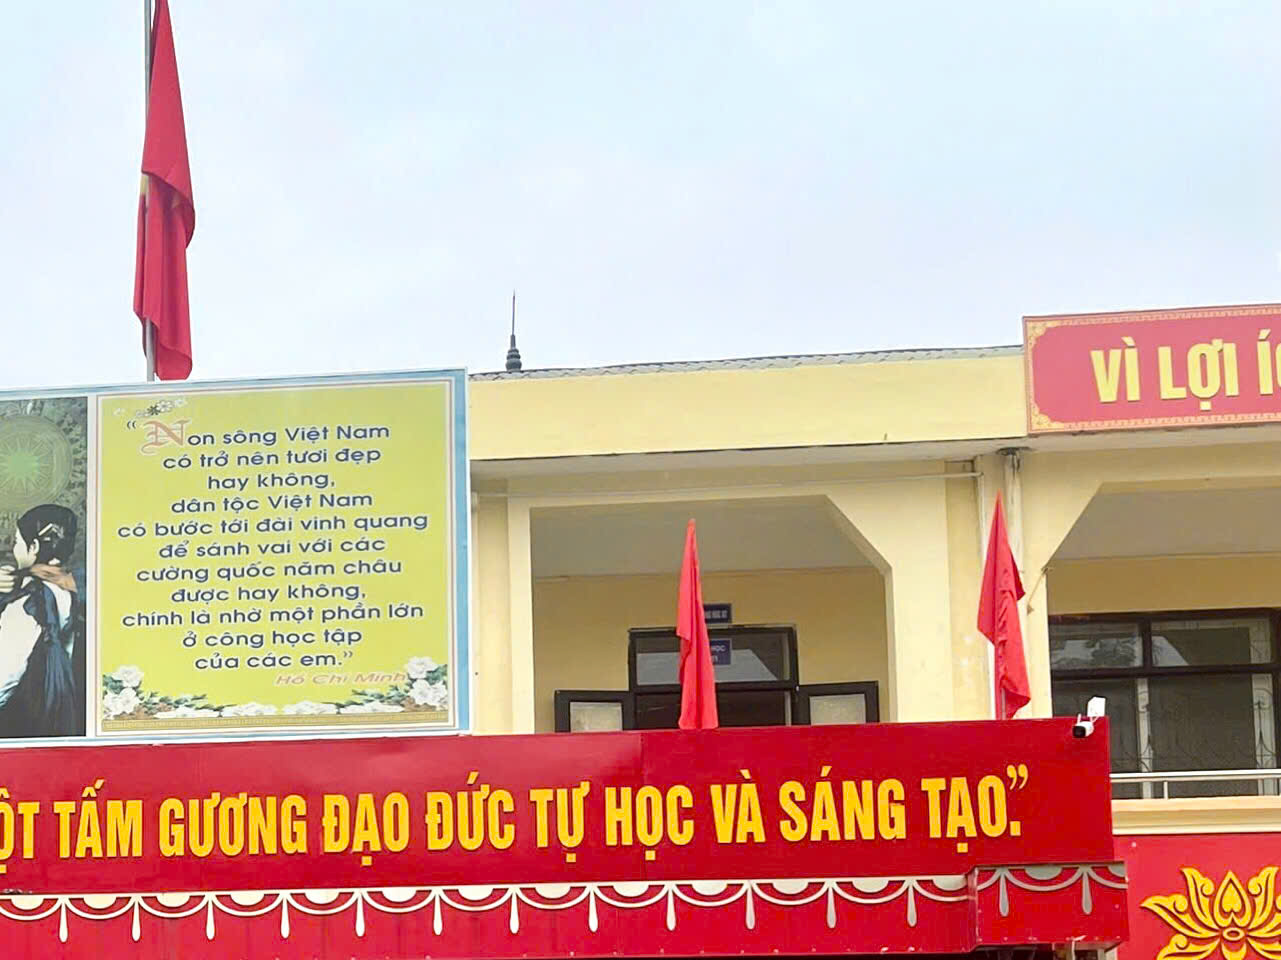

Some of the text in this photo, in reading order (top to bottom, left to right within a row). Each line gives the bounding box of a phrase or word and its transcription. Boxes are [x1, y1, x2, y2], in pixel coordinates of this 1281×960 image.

[1090, 329, 1281, 410] VÌ LỢI Í
[222, 428, 277, 447] sông
[285, 427, 329, 443] Việt
[336, 425, 390, 440] Nam
[162, 448, 382, 470] có trở nên tươi đẹp
[208, 473, 335, 492] hay không,
[171, 493, 373, 514] dân tộc Việt Nam
[117, 515, 428, 538] có bước tới đài vinh quang
[158, 538, 385, 559] để sánh vai với các
[136, 559, 402, 583] cường quốc năm châu
[171, 584, 366, 605] được hay không,
[122, 602, 424, 627] chính là nhờ một phần lớn
[183, 628, 362, 649] ở công học tập
[194, 652, 239, 670] của
[246, 654, 292, 668] các
[54, 780, 142, 858] TẤM
[160, 792, 307, 856] GƯƠNG
[322, 792, 409, 865] ĐẠO
[425, 772, 514, 850] ĐỨC
[530, 781, 590, 862] TỰ
[605, 785, 694, 860] HỌC
[711, 770, 765, 843] VÀ
[779, 766, 906, 841] SÁNG
